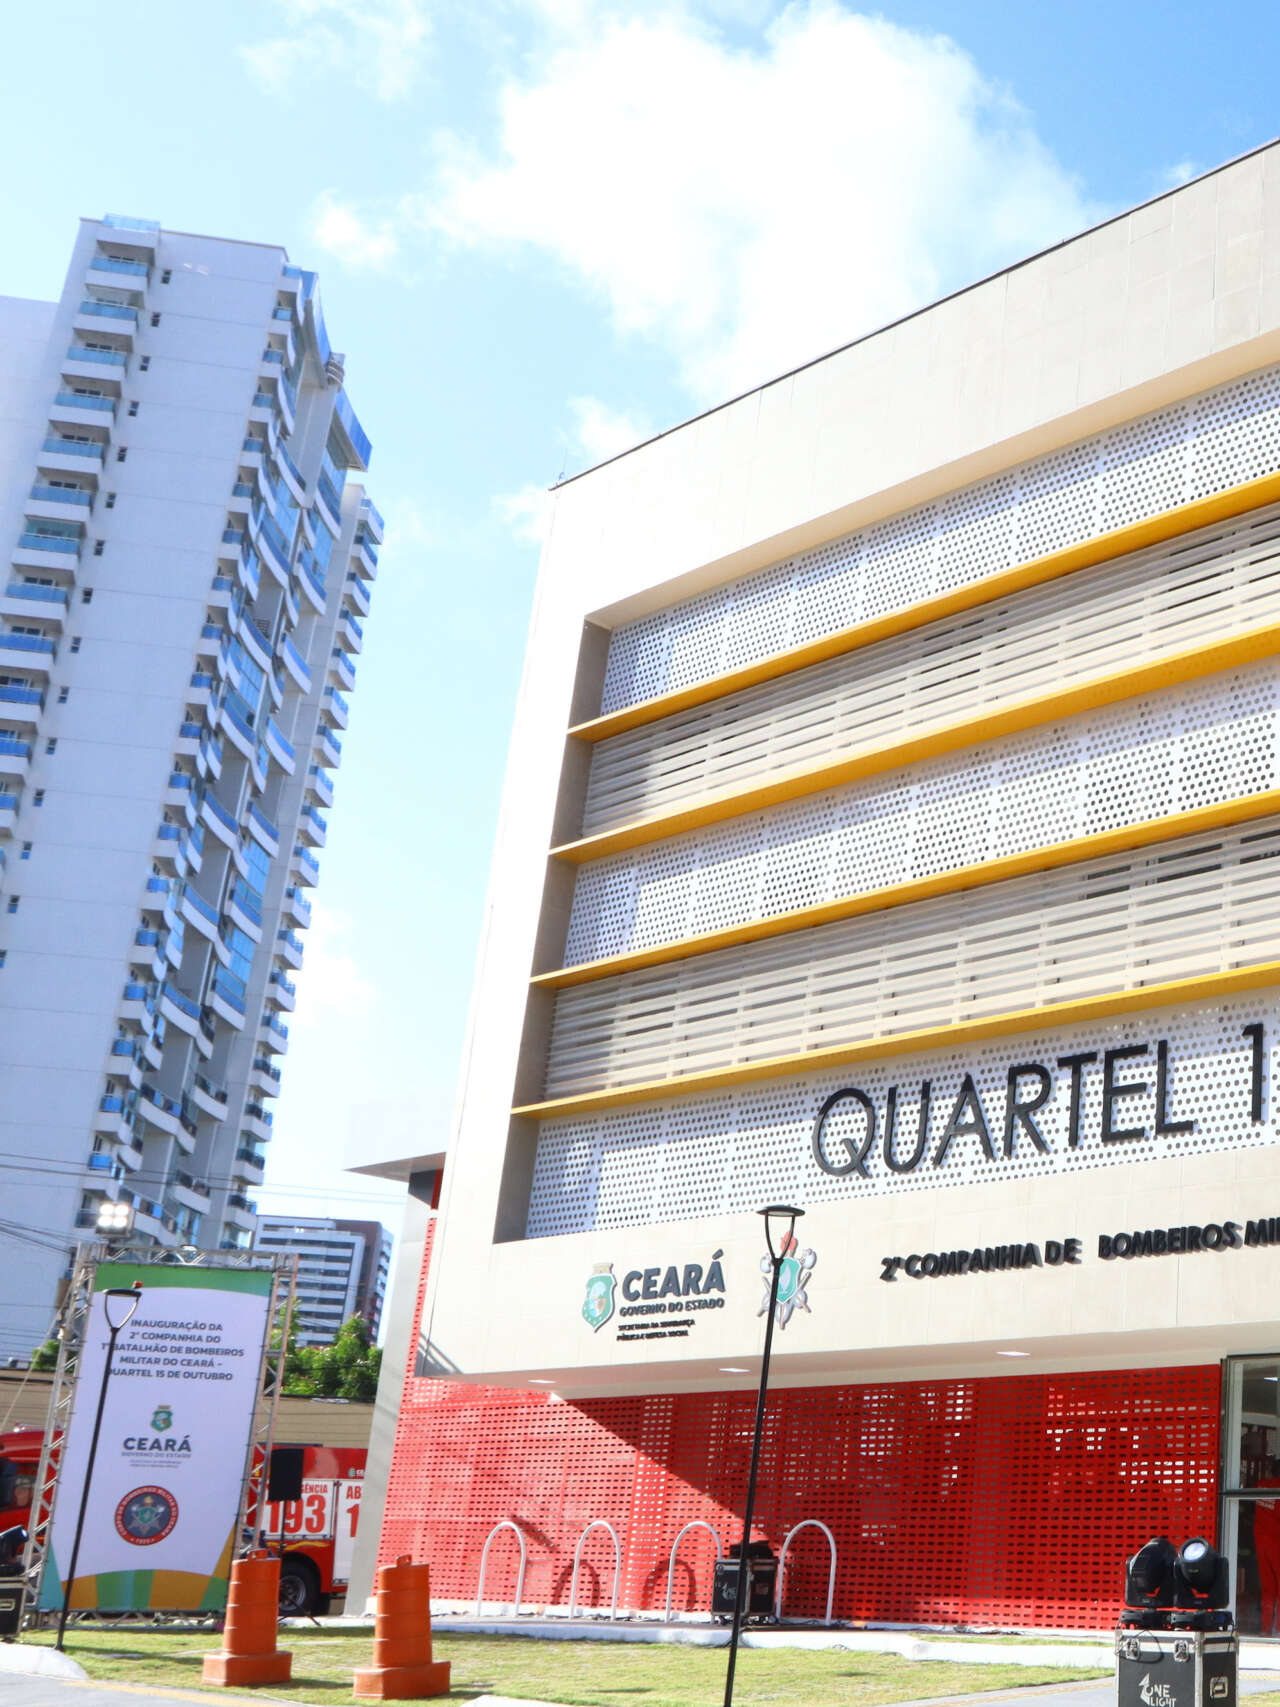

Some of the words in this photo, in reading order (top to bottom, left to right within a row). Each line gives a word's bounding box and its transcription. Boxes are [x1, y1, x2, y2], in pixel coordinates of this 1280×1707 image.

[810, 1039, 1195, 1180] QUARTEL
[905, 1242, 1043, 1280] COMPANHIA
[1045, 1237, 1083, 1266] DE
[1098, 1221, 1244, 1260] BOMBEIROS
[622, 1248, 726, 1302] CEARÁ
[619, 1303, 667, 1317] GOVERNO
[668, 1302, 683, 1313] DO
[685, 1297, 725, 1311] ESTADO
[131, 1319, 207, 1332] INAUGURAÇÃO
[208, 1323, 223, 1331] DA
[141, 1331, 203, 1342] COMPANHIA
[205, 1335, 221, 1343] DO
[169, 1346, 183, 1354] DE
[185, 1347, 244, 1357] BOMBEIROS
[120, 1355, 161, 1365] MILITAR
[163, 1358, 178, 1366] DO
[180, 1358, 215, 1368] CEARÁ
[156, 1369, 166, 1378] 15
[167, 1370, 181, 1379] DE
[183, 1371, 233, 1381] OUTUBRO
[123, 1434, 192, 1453] CEARÁ
[265, 1495, 326, 1534] 193
